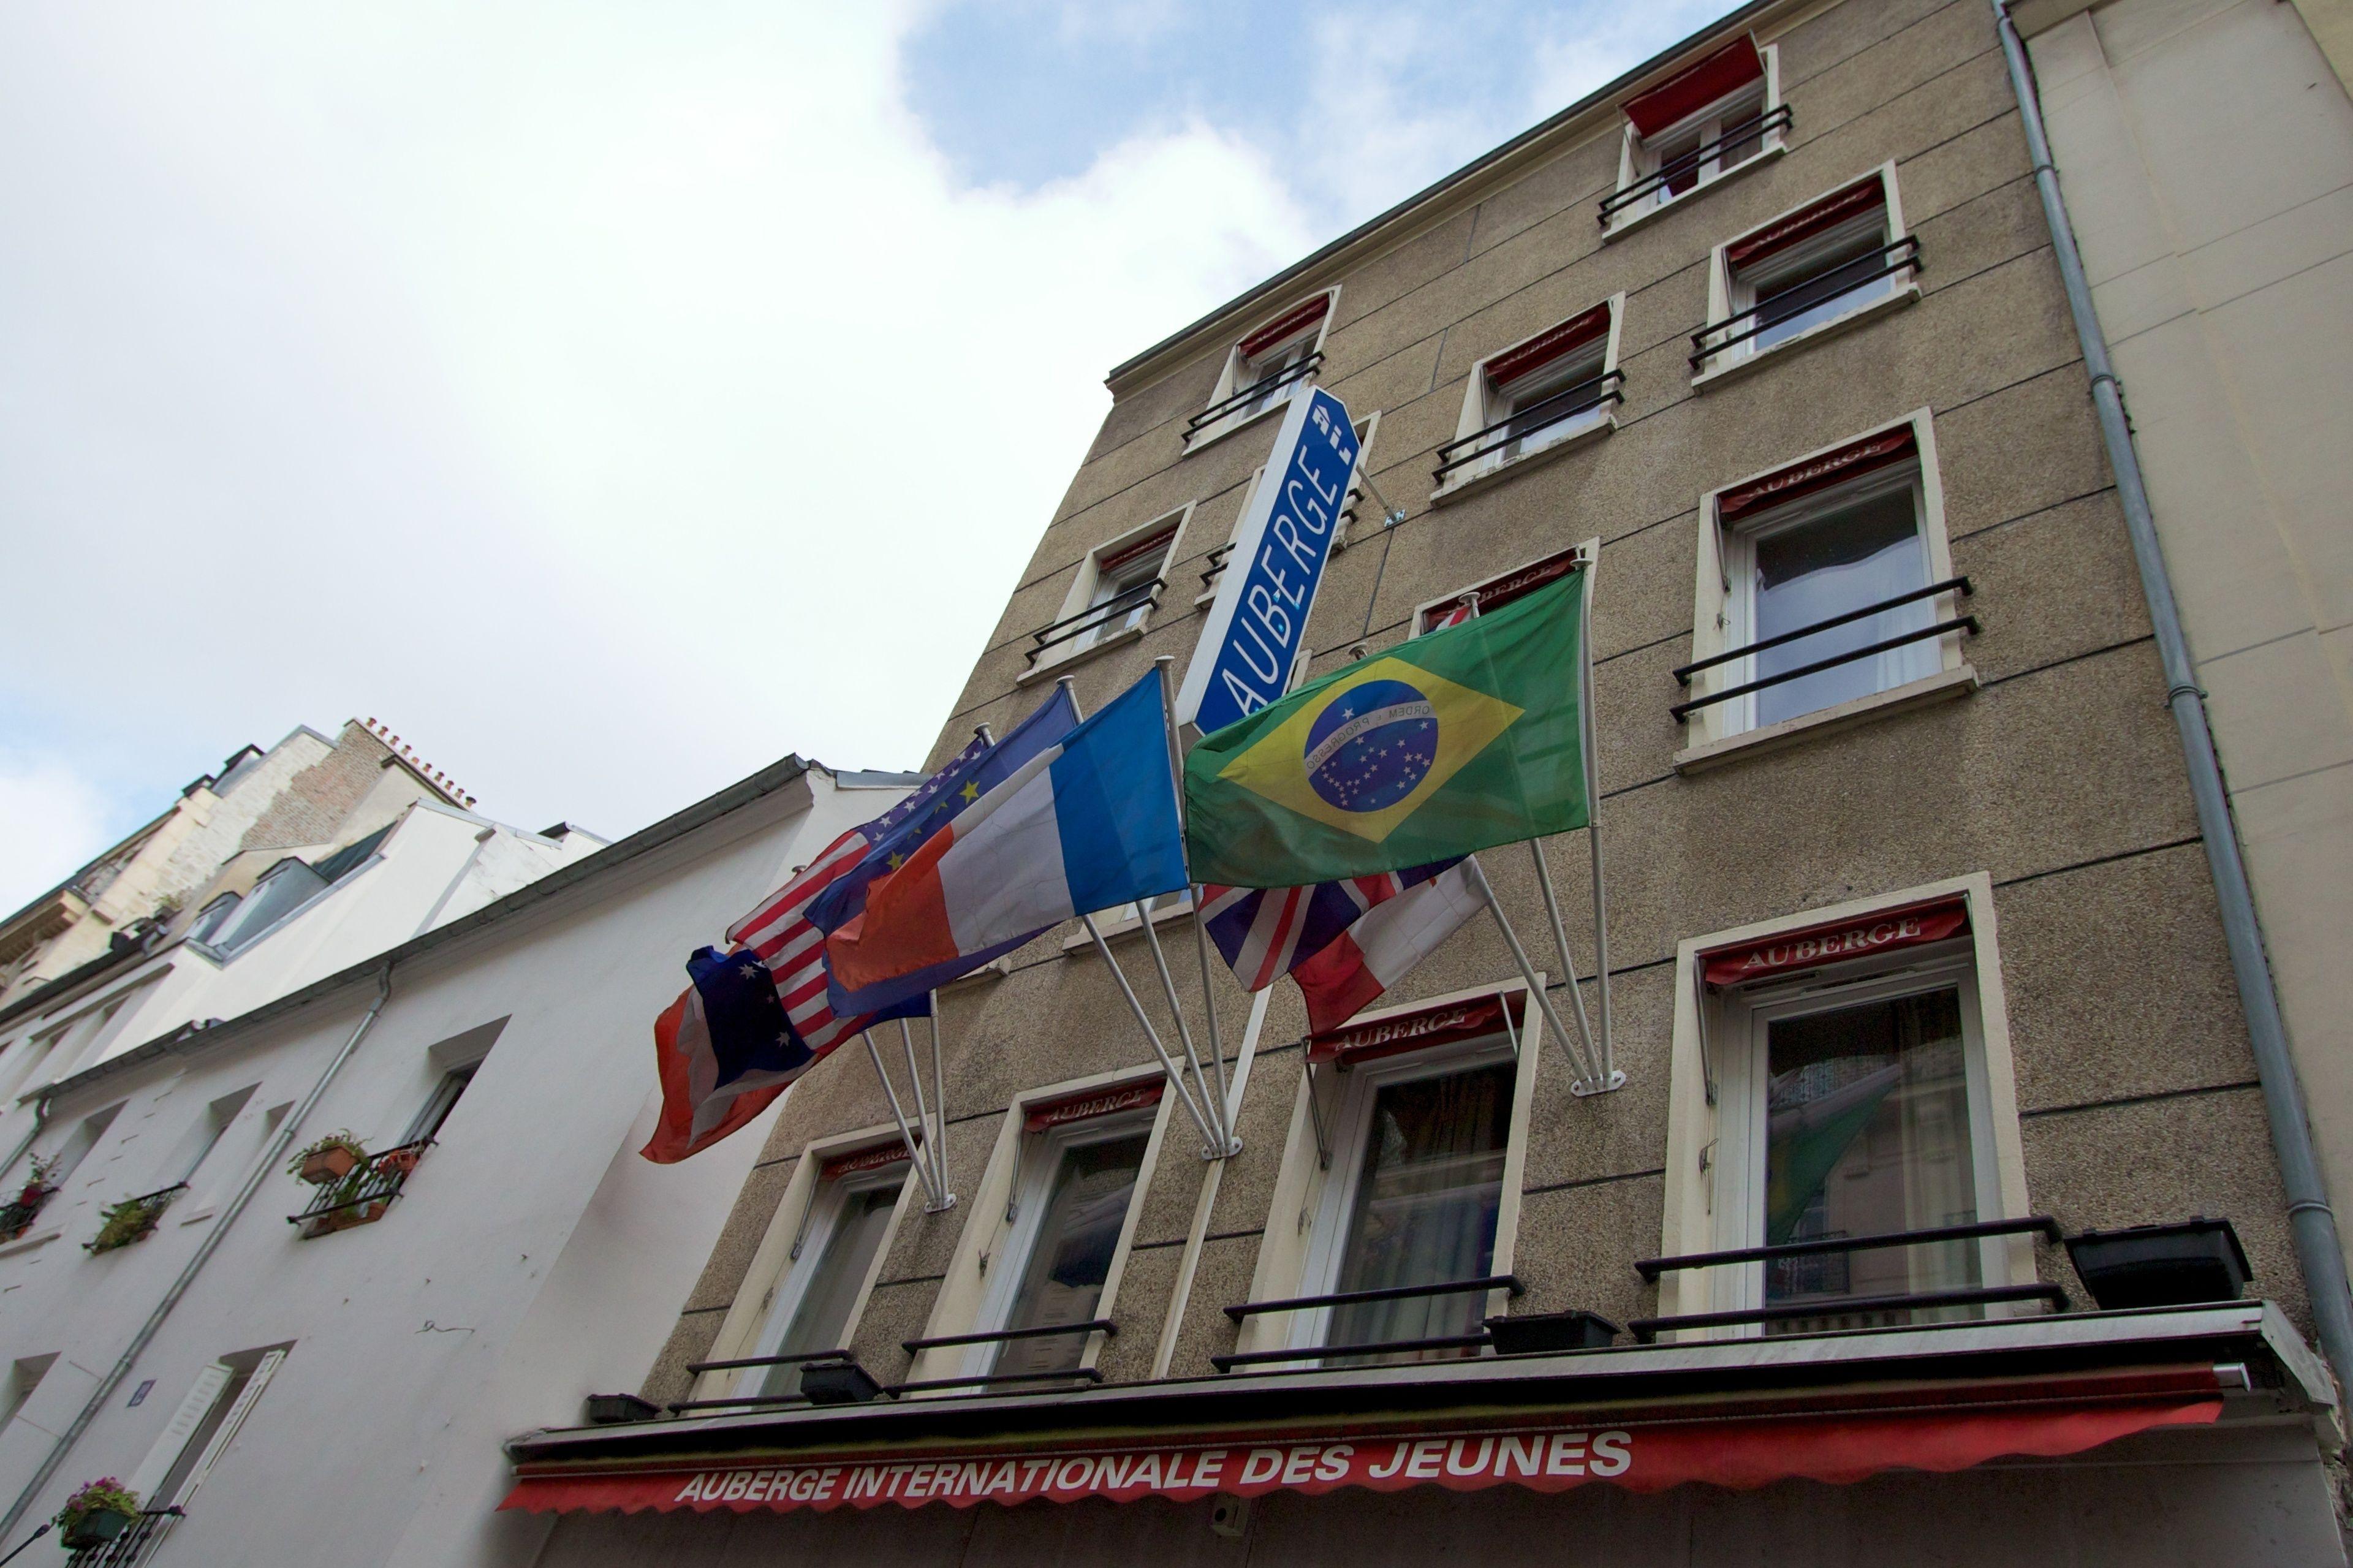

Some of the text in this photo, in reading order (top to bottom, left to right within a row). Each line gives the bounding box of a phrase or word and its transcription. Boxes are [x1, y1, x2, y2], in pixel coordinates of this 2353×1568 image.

[1741, 917, 1921, 969] AUBERGE
[1335, 1008, 1468, 1051] AUBERGE
[1046, 1088, 1148, 1122] AUBERGE
[675, 1431, 1632, 1502] AUBERGE INTERNATIONALE DES JEUNES
